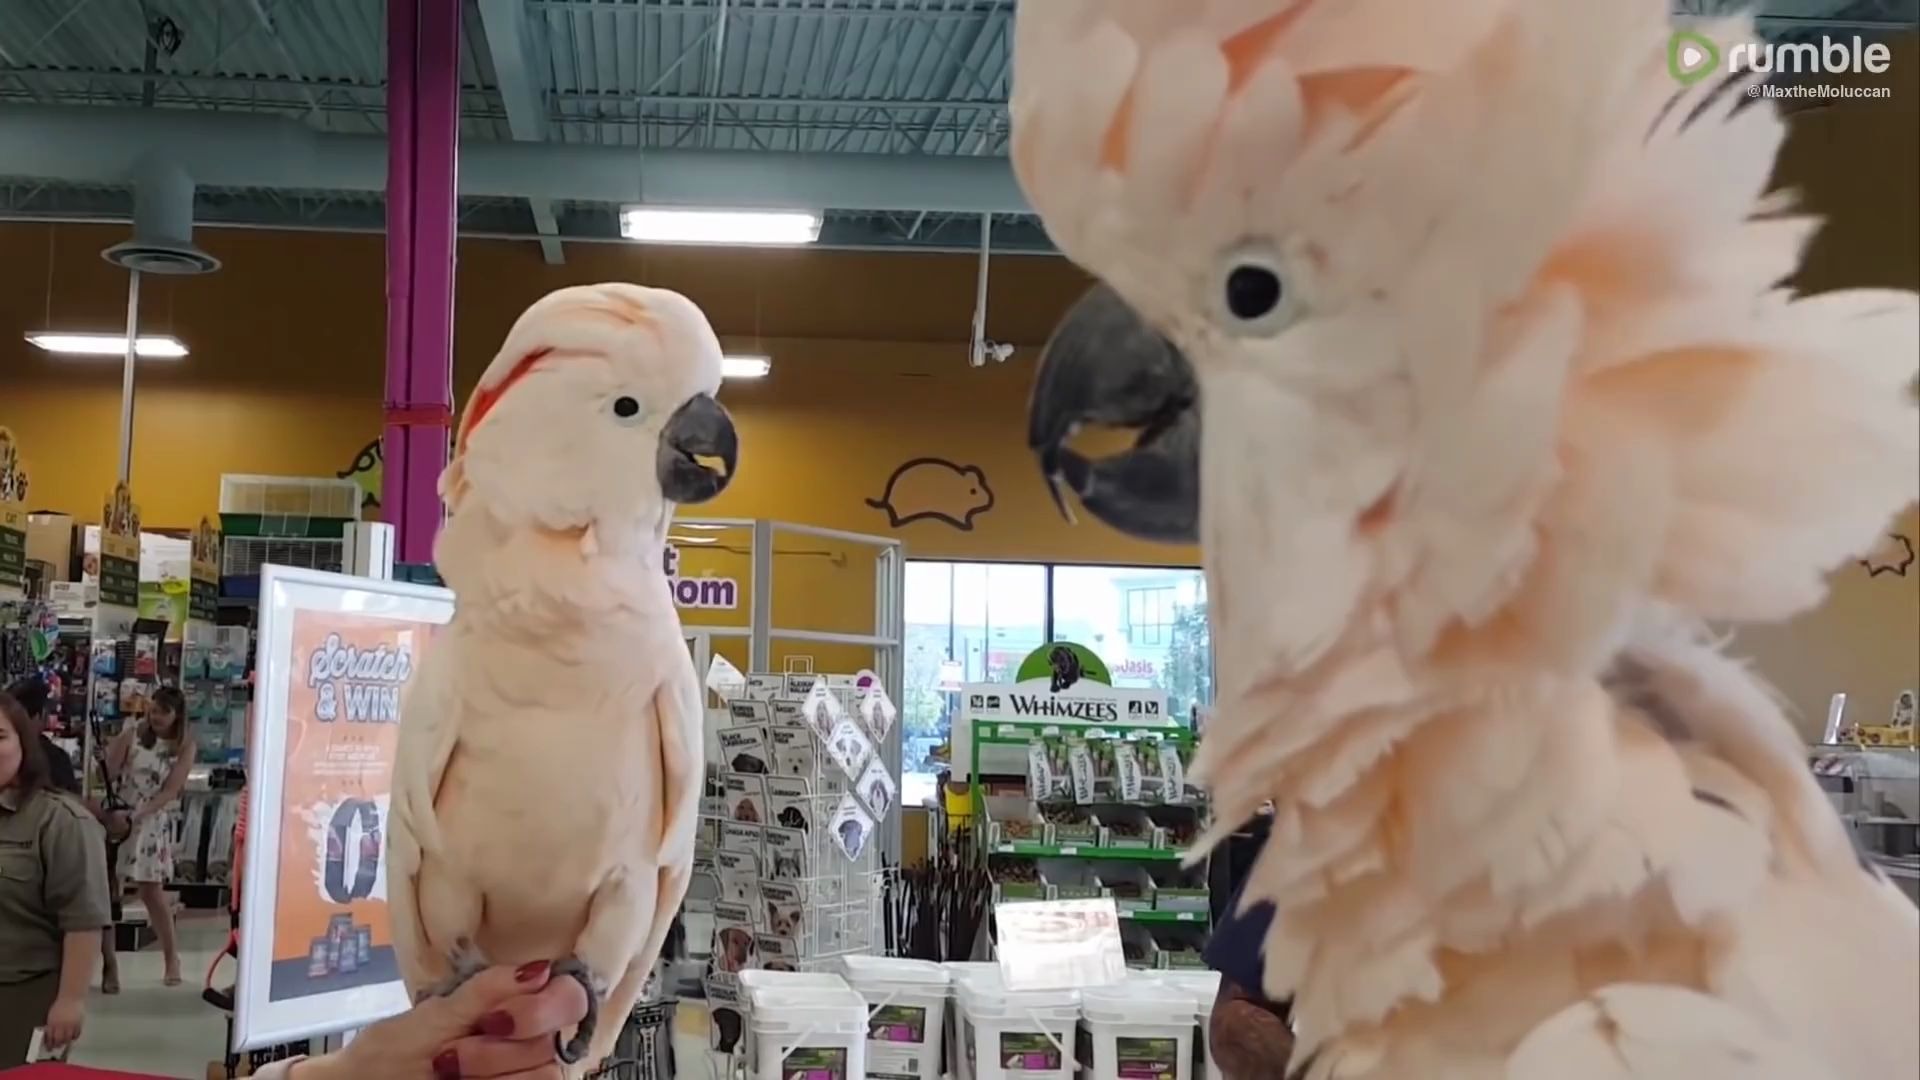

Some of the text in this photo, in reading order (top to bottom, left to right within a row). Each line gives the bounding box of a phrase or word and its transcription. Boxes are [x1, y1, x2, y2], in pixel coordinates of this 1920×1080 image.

[668, 580, 734, 605] om
[309, 632, 411, 687] Scratch
[316, 682, 400, 723] & WIN
